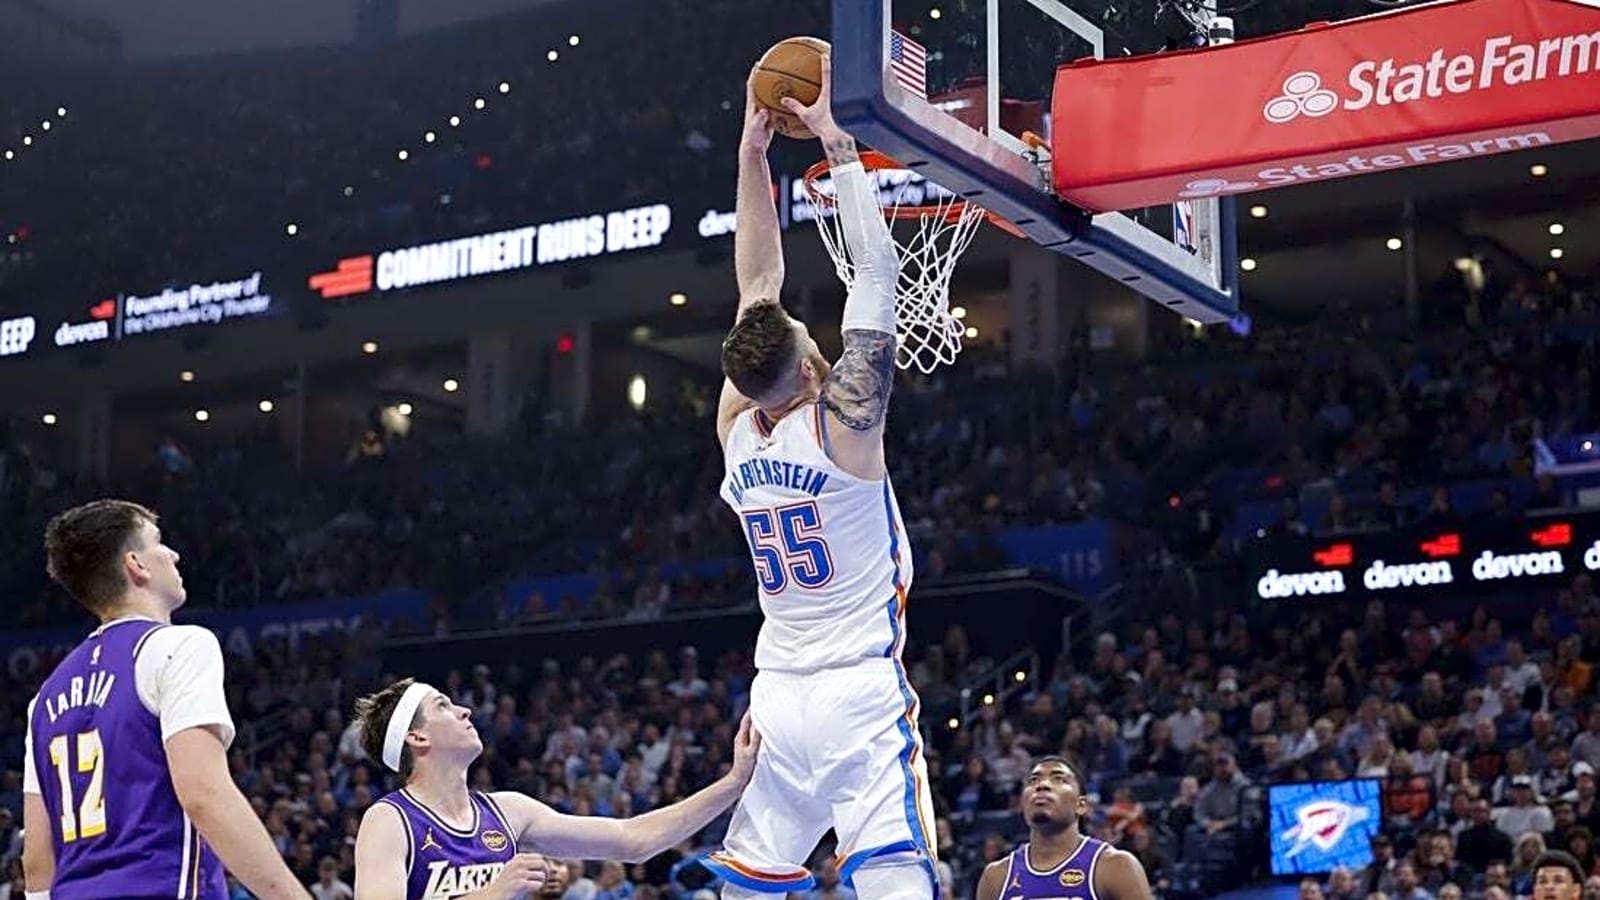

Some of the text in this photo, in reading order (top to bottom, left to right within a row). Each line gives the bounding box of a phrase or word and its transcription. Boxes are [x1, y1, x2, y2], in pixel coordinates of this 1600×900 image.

[1343, 30, 1600, 111] State Farm
[1255, 131, 1552, 186] State Farm
[377, 204, 670, 290] COMMITMENT RUNS DEEP
[699, 210, 736, 237] dev
[126, 271, 260, 316] Founding Partner of
[143, 308, 200, 331] Oklahoma
[200, 303, 222, 323] City
[223, 294, 270, 316] Thunder
[55, 321, 108, 346] devon
[741, 500, 834, 595] 55
[1257, 569, 1345, 598] devon
[1363, 560, 1453, 590] devon
[1472, 550, 1563, 581] devon
[49, 728, 107, 843] 12
[422, 860, 506, 900] LAKER
